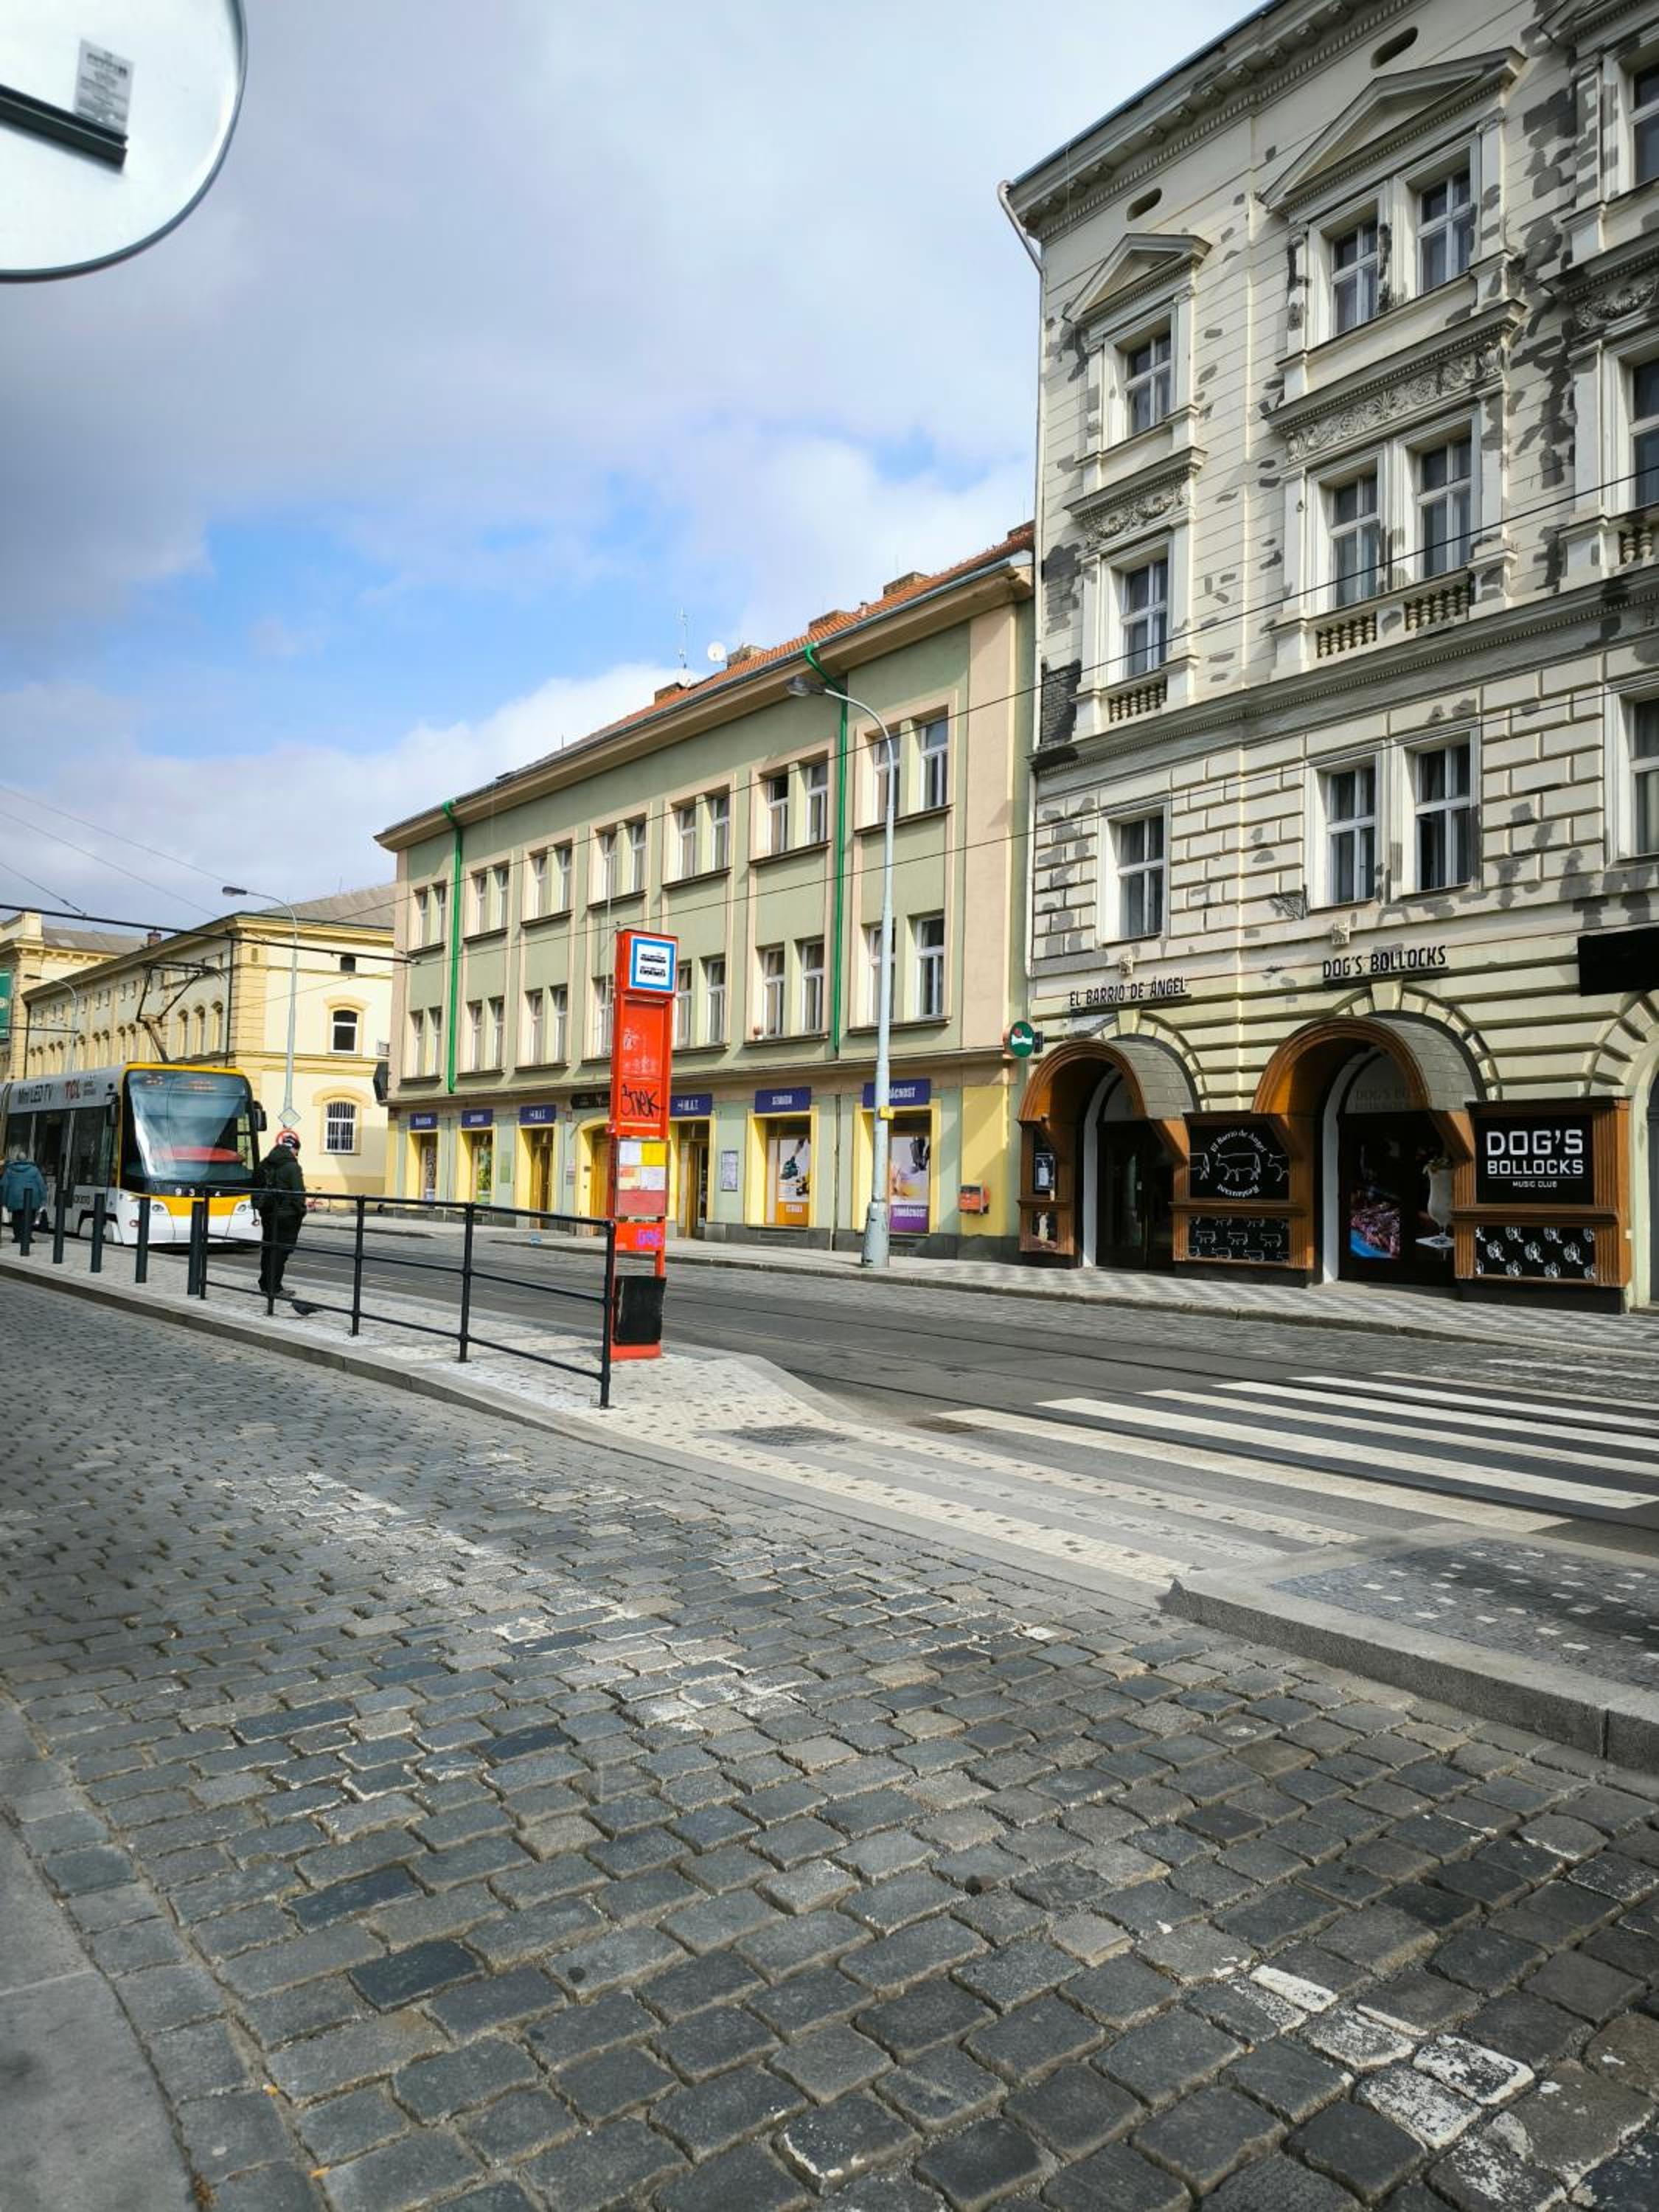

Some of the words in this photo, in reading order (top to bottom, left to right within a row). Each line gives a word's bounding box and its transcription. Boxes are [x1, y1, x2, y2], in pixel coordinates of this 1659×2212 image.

[1322, 955, 1363, 978] DOG'S
[1370, 945, 1447, 973] BOLLOCKS
[1070, 990, 1081, 1006] EL
[1086, 985, 1125, 1004] BARRIO
[1130, 981, 1145, 1000] DE
[1150, 975, 1186, 997] ÁNGEL
[1486, 1128, 1583, 1156] DOG'S
[1487, 1159, 1584, 1175] BOLLOCKS
